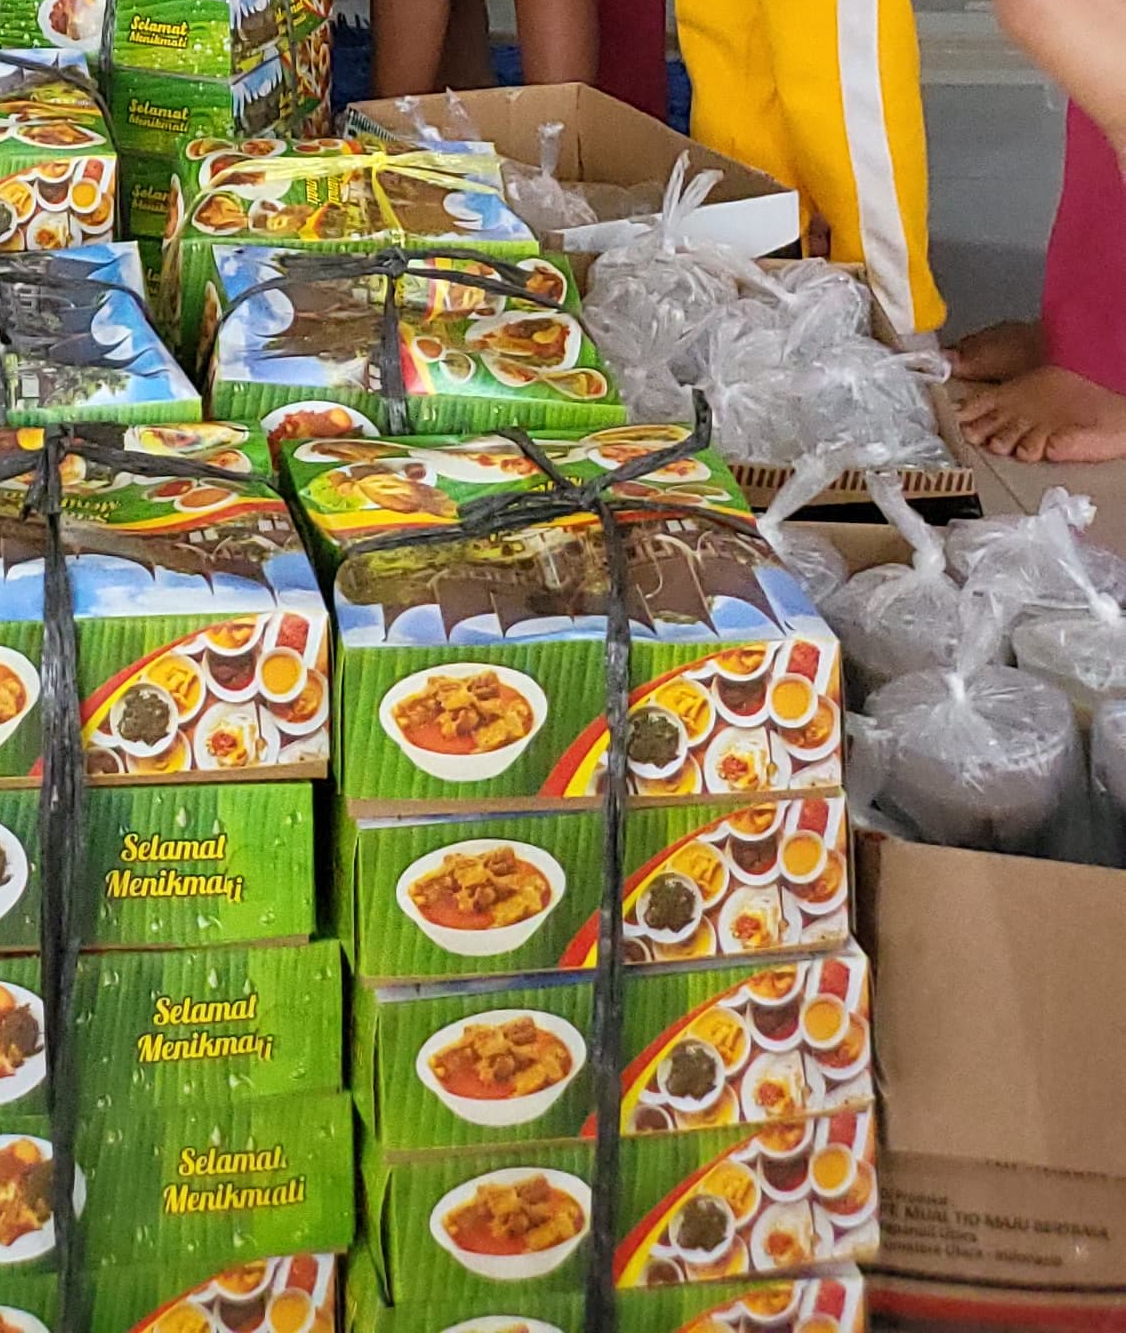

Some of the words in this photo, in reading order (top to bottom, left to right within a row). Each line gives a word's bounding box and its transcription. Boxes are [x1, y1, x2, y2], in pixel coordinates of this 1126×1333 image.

[128, 31, 188, 49] Menikmati
[130, 14, 188, 36] Selamat
[128, 99, 190, 121] Selamat
[119, 833, 226, 862] Selamat
[104, 870, 244, 903] Menikmati
[152, 993, 259, 1025] Selamat
[137, 1030, 273, 1064] Menikmati
[178, 1144, 288, 1176] Selamat
